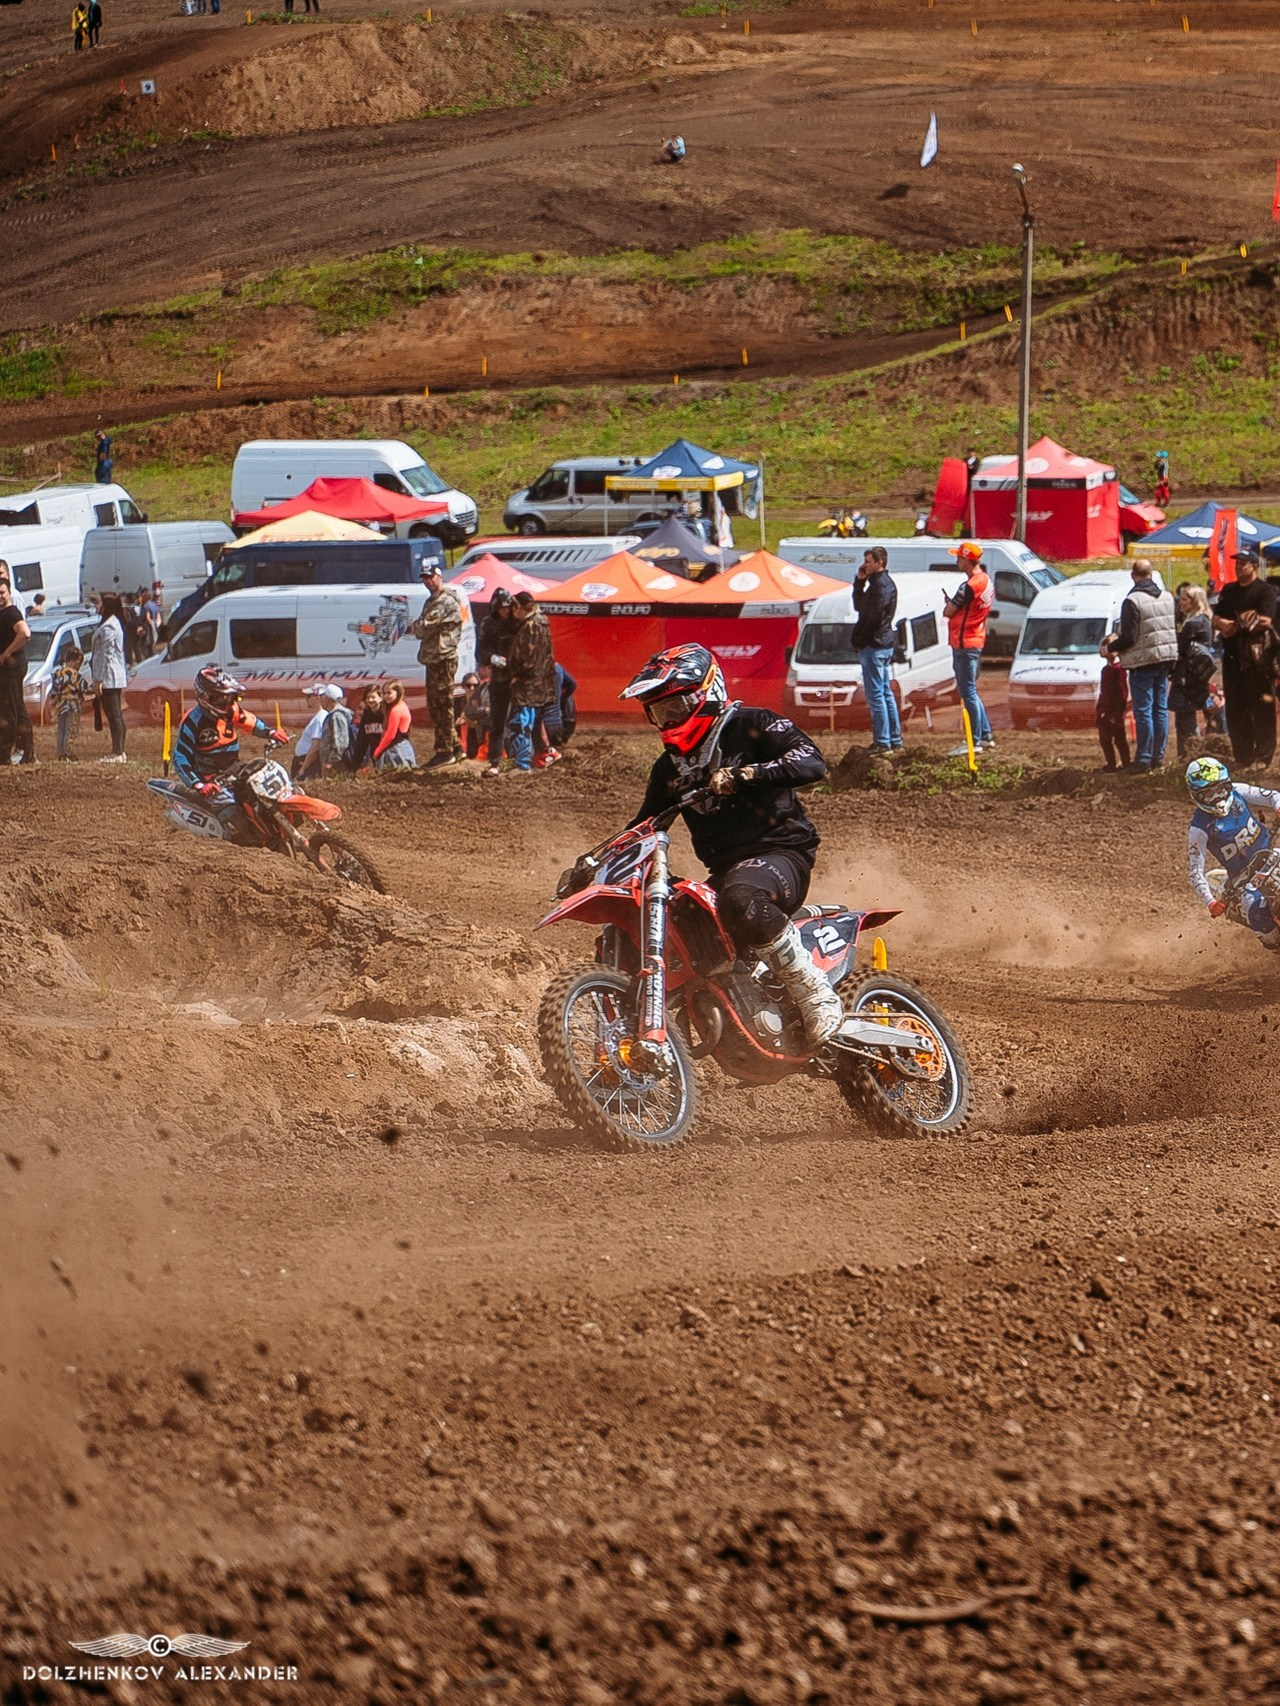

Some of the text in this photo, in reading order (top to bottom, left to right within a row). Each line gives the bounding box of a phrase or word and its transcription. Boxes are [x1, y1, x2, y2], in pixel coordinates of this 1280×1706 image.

[538, 603, 651, 616] OTOCROSS ENDURO
[262, 769, 288, 796] 51
[187, 811, 209, 829] 51
[1220, 816, 1260, 862] DRC
[812, 925, 848, 955] 2
